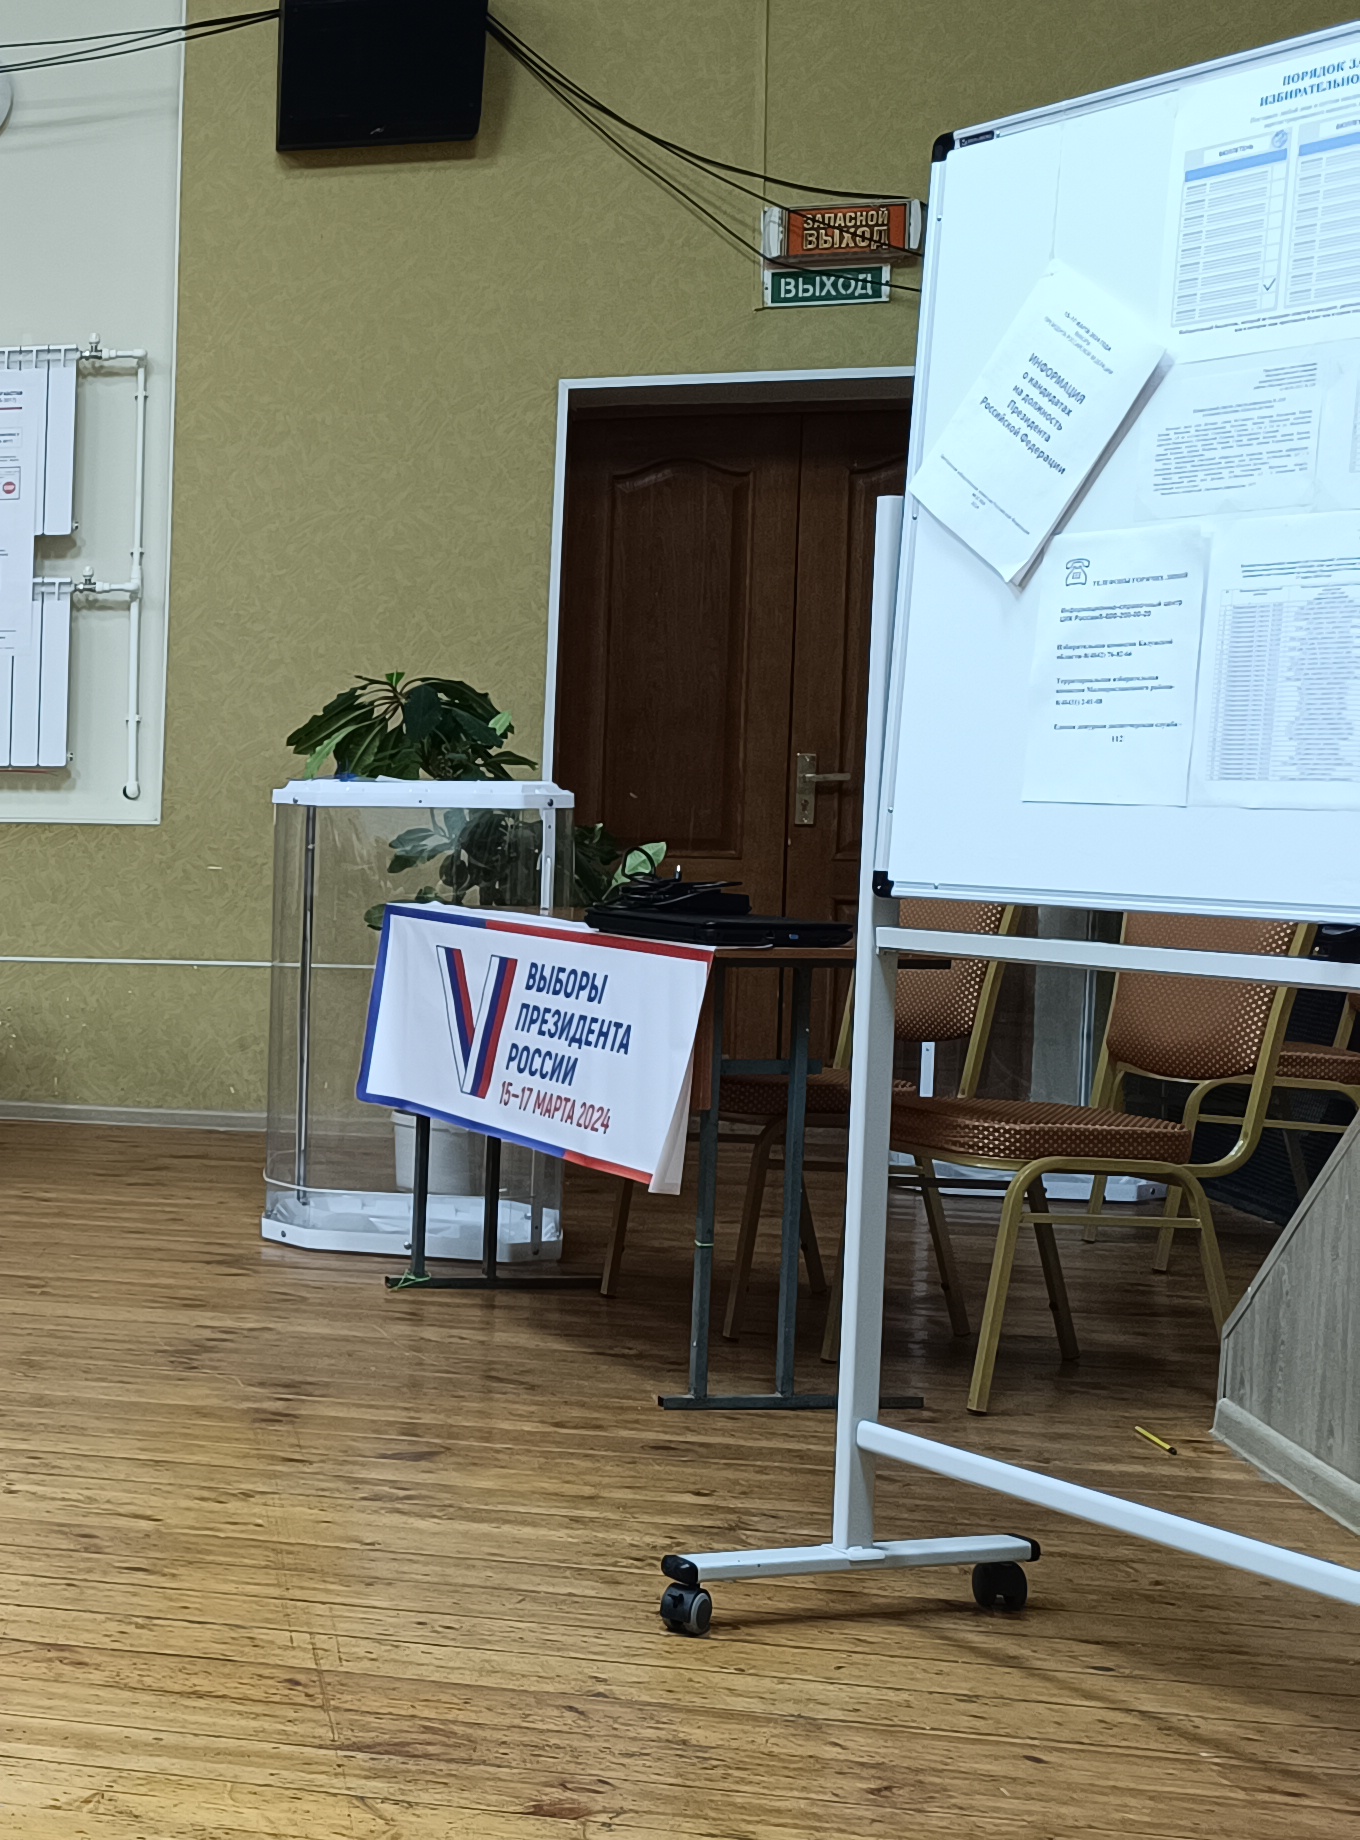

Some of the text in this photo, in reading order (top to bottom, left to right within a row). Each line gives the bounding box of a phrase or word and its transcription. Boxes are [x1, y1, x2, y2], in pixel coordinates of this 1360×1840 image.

[1283, 60, 1346, 86] ПОРЯДОК
[803, 208, 888, 228] ЗАПАСНОЙ
[803, 227, 888, 250] ВЫХОД
[780, 273, 873, 298] ВЫХОД
[1028, 353, 1086, 405] ИНФОРМАЦИЯ
[1028, 376, 1073, 417] кандидатах
[1007, 399, 1051, 442] Президента
[1012, 385, 1063, 431] на должность
[980, 396, 1066, 475] Российской Федерации
[525, 962, 609, 1004] ВЫБОРЫ
[515, 1002, 632, 1055] ПРЕЗИДЕНТА
[506, 1043, 579, 1086] РОССИИ
[532, 1090, 576, 1125] МАРТА
[576, 1102, 611, 1134] 2024
